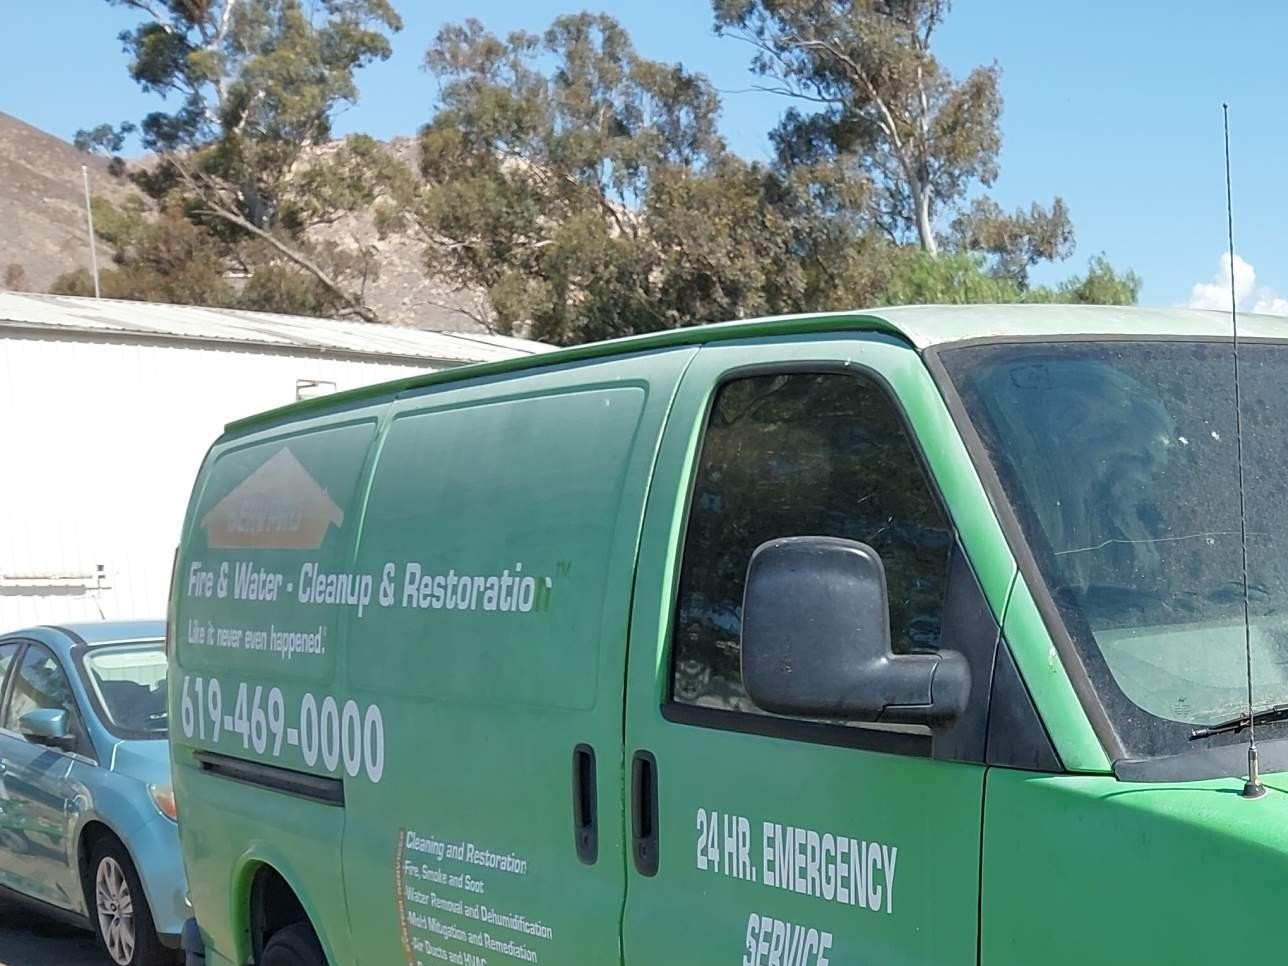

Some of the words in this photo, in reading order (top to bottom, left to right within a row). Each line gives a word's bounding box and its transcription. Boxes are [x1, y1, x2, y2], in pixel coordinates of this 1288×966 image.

[188, 561, 214, 598] Fire
[217, 561, 229, 598] &
[234, 562, 283, 601] Water
[298, 562, 373, 618] Cleanup
[379, 562, 396, 607] &
[188, 618, 206, 646] Like
[207, 620, 215, 646] it
[217, 628, 243, 649] never
[244, 629, 267, 651] even
[180, 676, 385, 783] 619-469-0000
[404, 860, 421, 880] Fire,
[422, 865, 447, 884] Smoke
[449, 873, 463, 888] and
[464, 875, 485, 894] Soot
[406, 830, 445, 861] Cleaning
[446, 842, 465, 861] and
[466, 843, 528, 875] Restoration
[696, 807, 720, 873] 24
[724, 813, 757, 882] HR.
[763, 821, 898, 914] EMERGENCY
[405, 885, 429, 905] Water
[430, 892, 463, 915] Removal
[464, 904, 479, 919] and
[481, 905, 553, 941] Dehumidification
[408, 911, 427, 930] Mold
[467, 932, 483, 947] and
[483, 932, 538, 964] Remediation
[424, 940, 448, 960] Ducts
[448, 951, 463, 965] and
